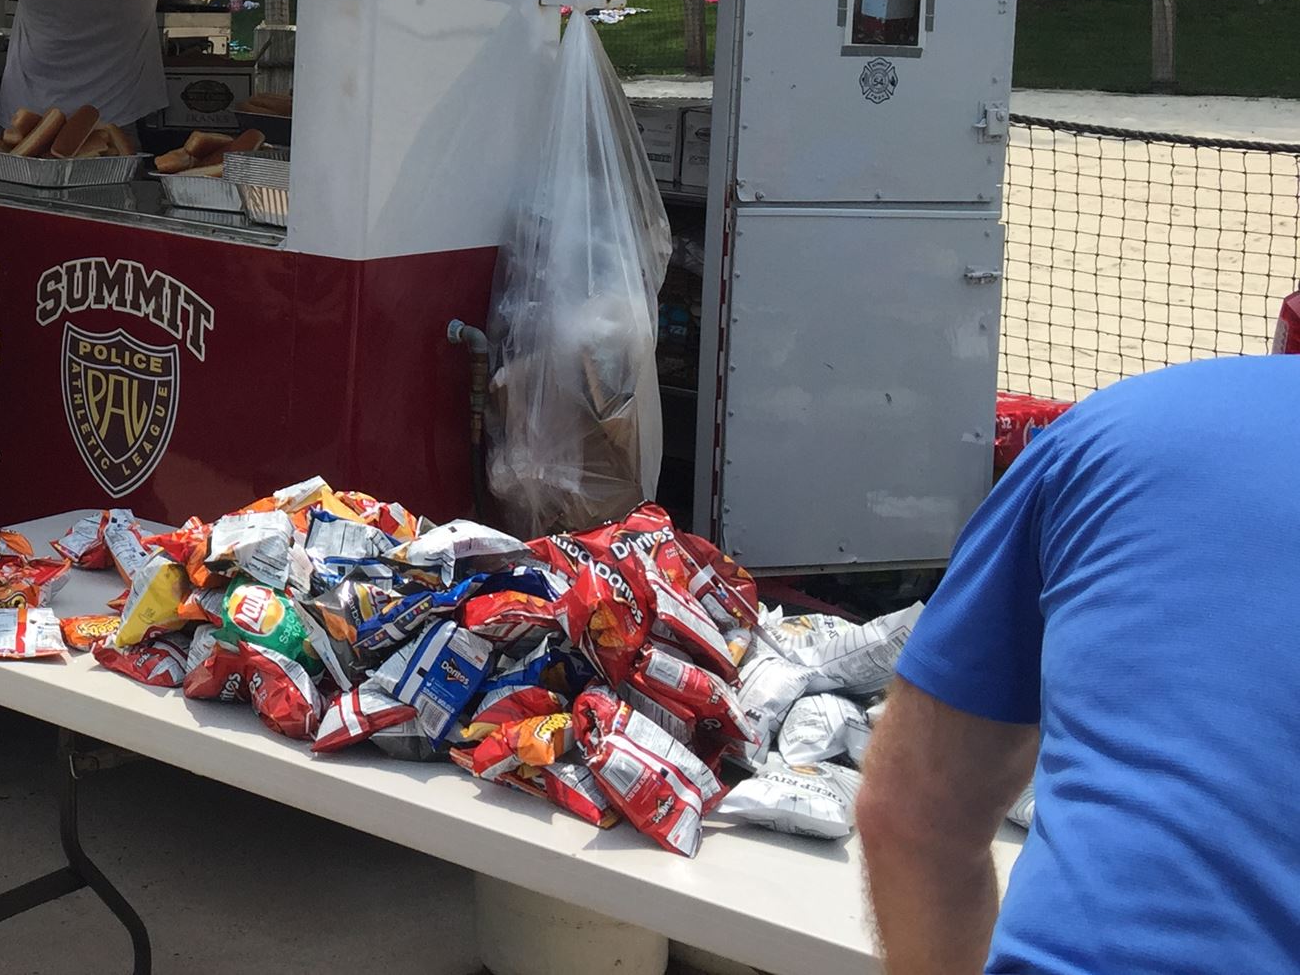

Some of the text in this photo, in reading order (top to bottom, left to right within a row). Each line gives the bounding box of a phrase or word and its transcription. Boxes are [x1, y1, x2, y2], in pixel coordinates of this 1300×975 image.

[36, 257, 215, 362] SUMMIT
[79, 341, 164, 374] POLICE
[71, 362, 110, 471] ATHLETIC
[122, 385, 169, 476] LEAGUE
[595, 562, 644, 625] Doritos
[440, 658, 471, 686] Doritos
